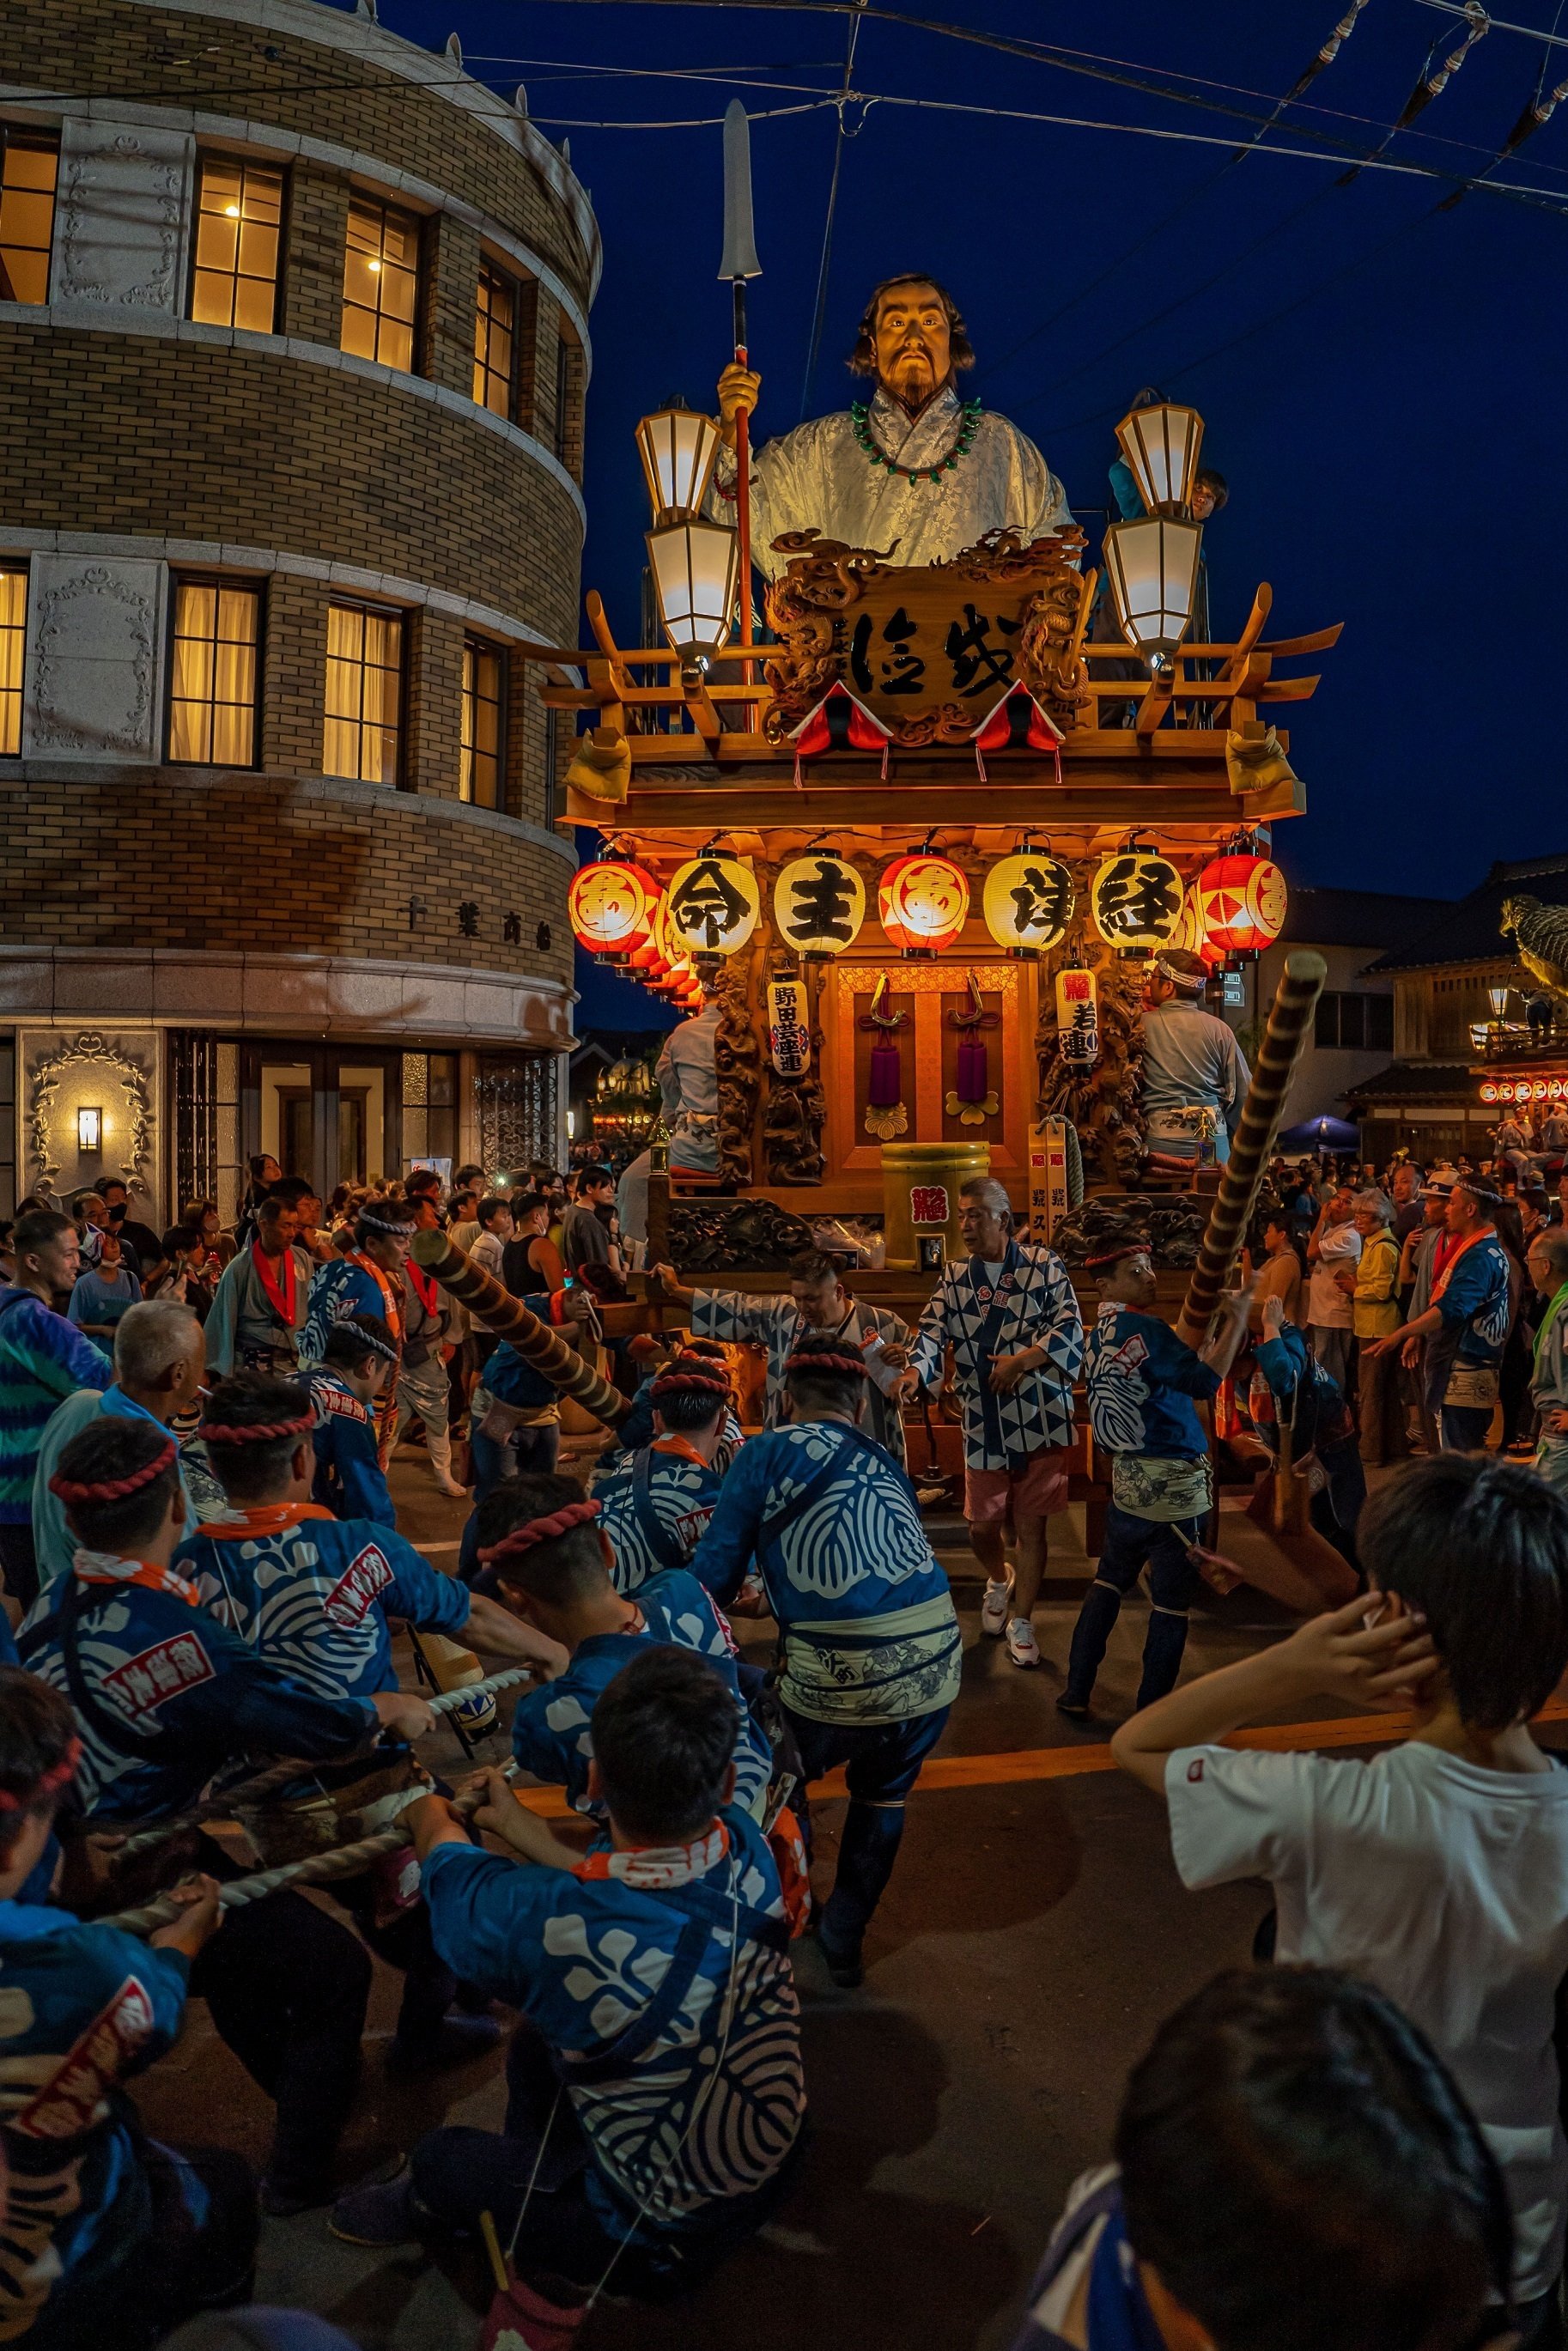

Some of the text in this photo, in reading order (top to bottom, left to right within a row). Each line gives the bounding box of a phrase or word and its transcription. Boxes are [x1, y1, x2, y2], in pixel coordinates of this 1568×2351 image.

[670, 860, 751, 949] 命
[787, 860, 858, 943] 主
[1097, 859, 1182, 940] 経
[775, 987, 803, 1072] 野田芸座連
